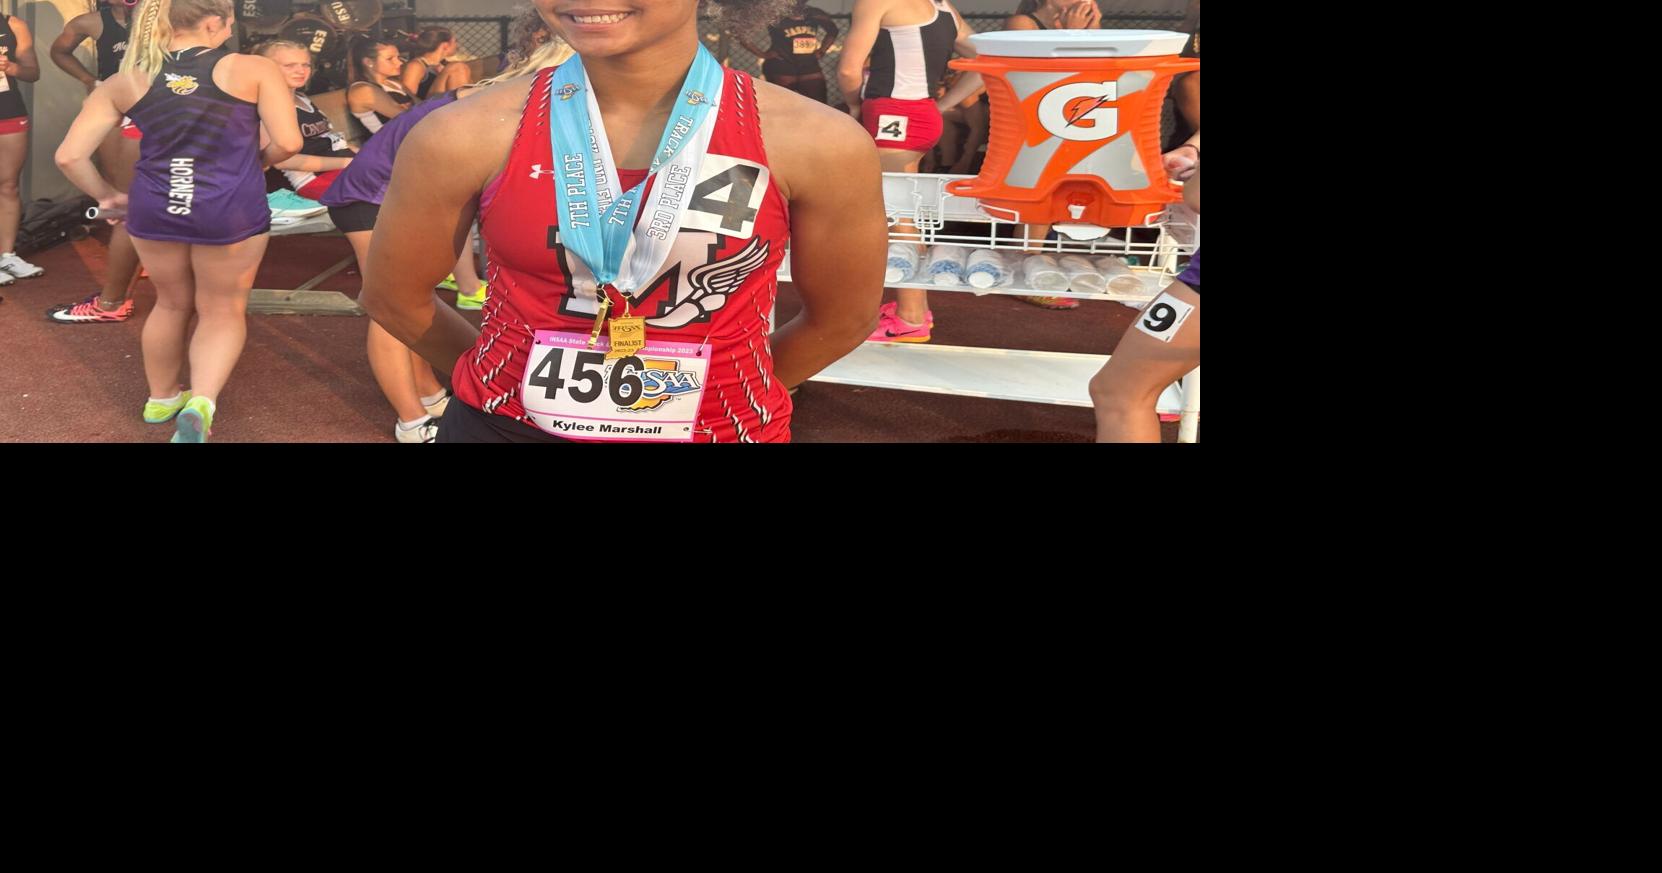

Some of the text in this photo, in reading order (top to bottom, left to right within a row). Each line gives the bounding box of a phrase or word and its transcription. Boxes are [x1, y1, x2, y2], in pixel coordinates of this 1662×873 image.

[310, 29, 328, 53] ESU
[881, 121, 902, 138] 4
[1037, 80, 1118, 142] G
[166, 158, 195, 215] HORNETS
[565, 152, 590, 229] 7TH PLACE
[646, 164, 692, 241] 3RD PLACE
[687, 163, 761, 233] 4
[608, 198, 633, 226] 7TH
[1143, 302, 1177, 333] 9
[614, 340, 643, 348] FINALIST
[528, 347, 645, 407] 456
[552, 419, 662, 434] Kylee Marshall
